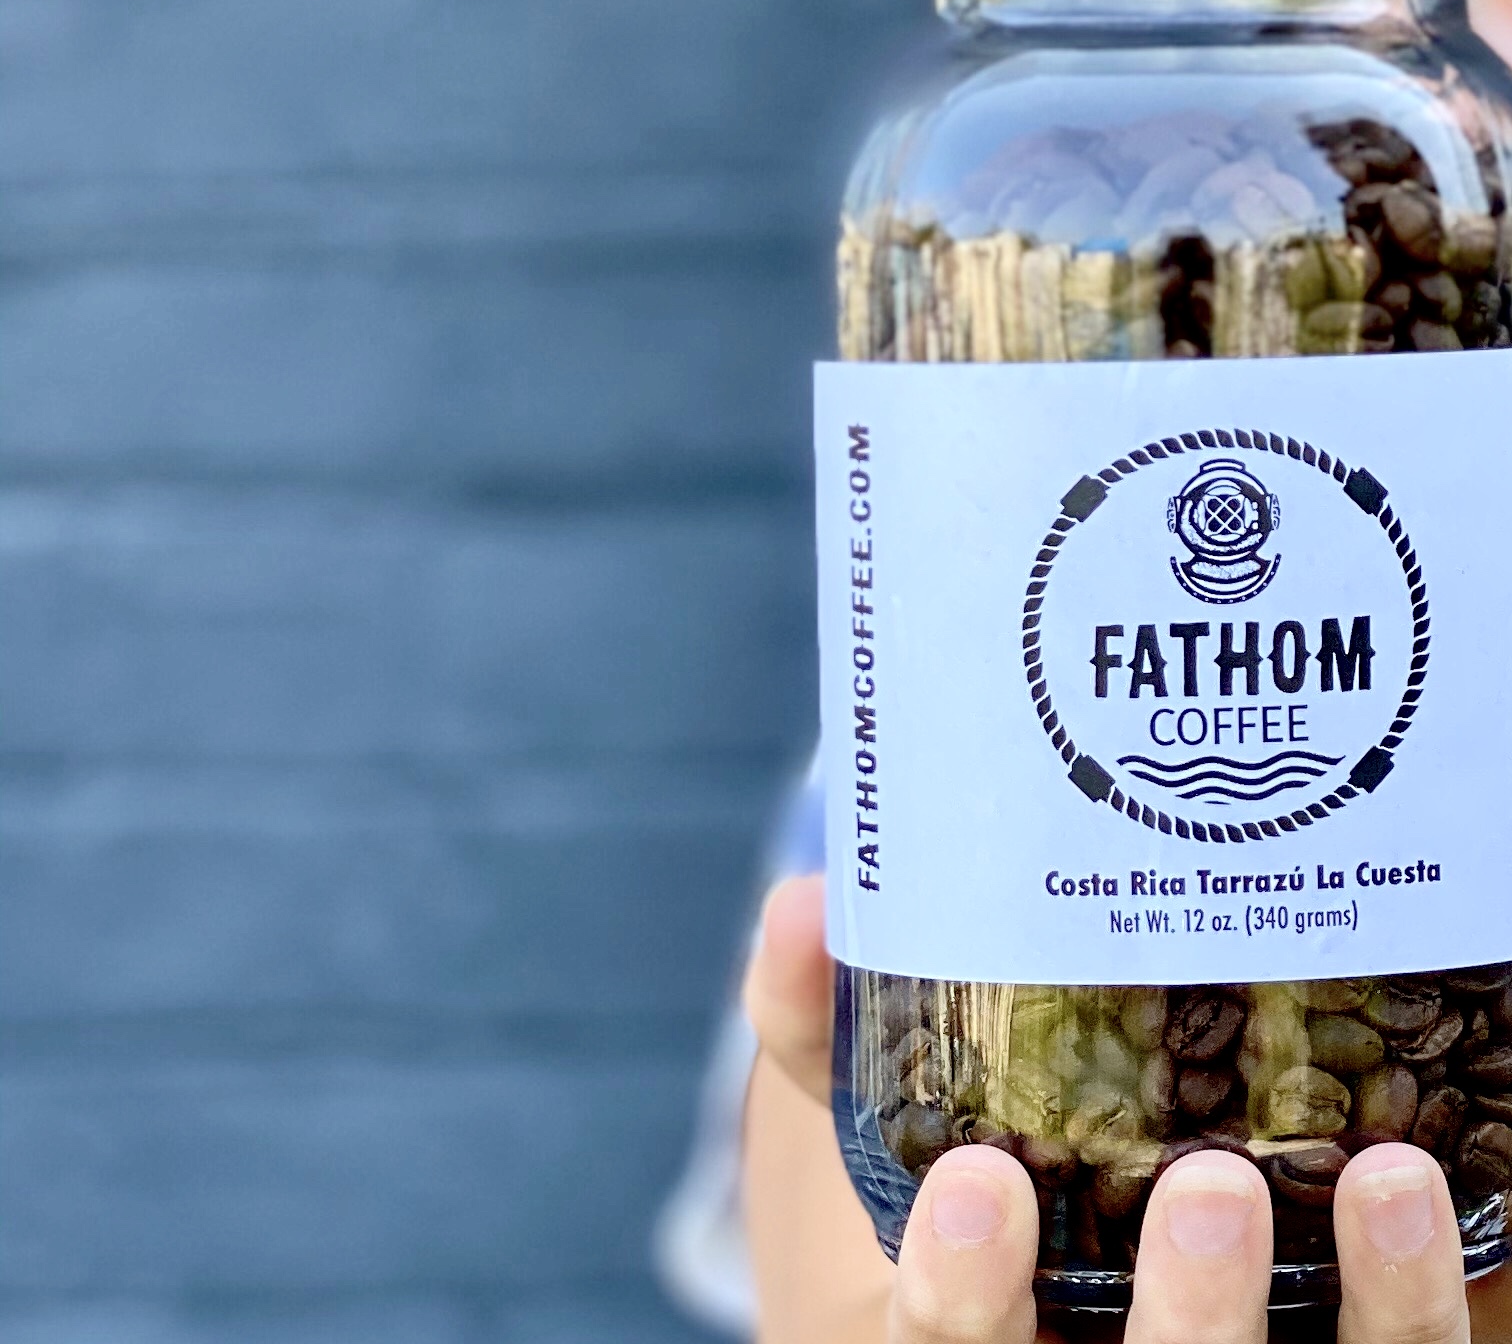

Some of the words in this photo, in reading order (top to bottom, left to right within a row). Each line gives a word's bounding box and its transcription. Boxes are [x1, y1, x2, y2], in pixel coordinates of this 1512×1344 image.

[847, 422, 881, 892] FATHOMCOFFEE.COM
[1089, 614, 1377, 699] FATHOM
[1149, 704, 1310, 747] COFFEE
[1045, 870, 1119, 897] Costa
[1130, 869, 1186, 897] Rica
[1196, 865, 1305, 895] Tarrazú
[1316, 864, 1345, 890] La
[1355, 859, 1441, 888] Cuesta
[1110, 909, 1141, 934] Net
[1145, 909, 1176, 934] Wt.
[1183, 908, 1205, 933] 12
[1211, 915, 1238, 932] oz.
[1245, 904, 1289, 937] (340
[1295, 899, 1358, 935] grams)
